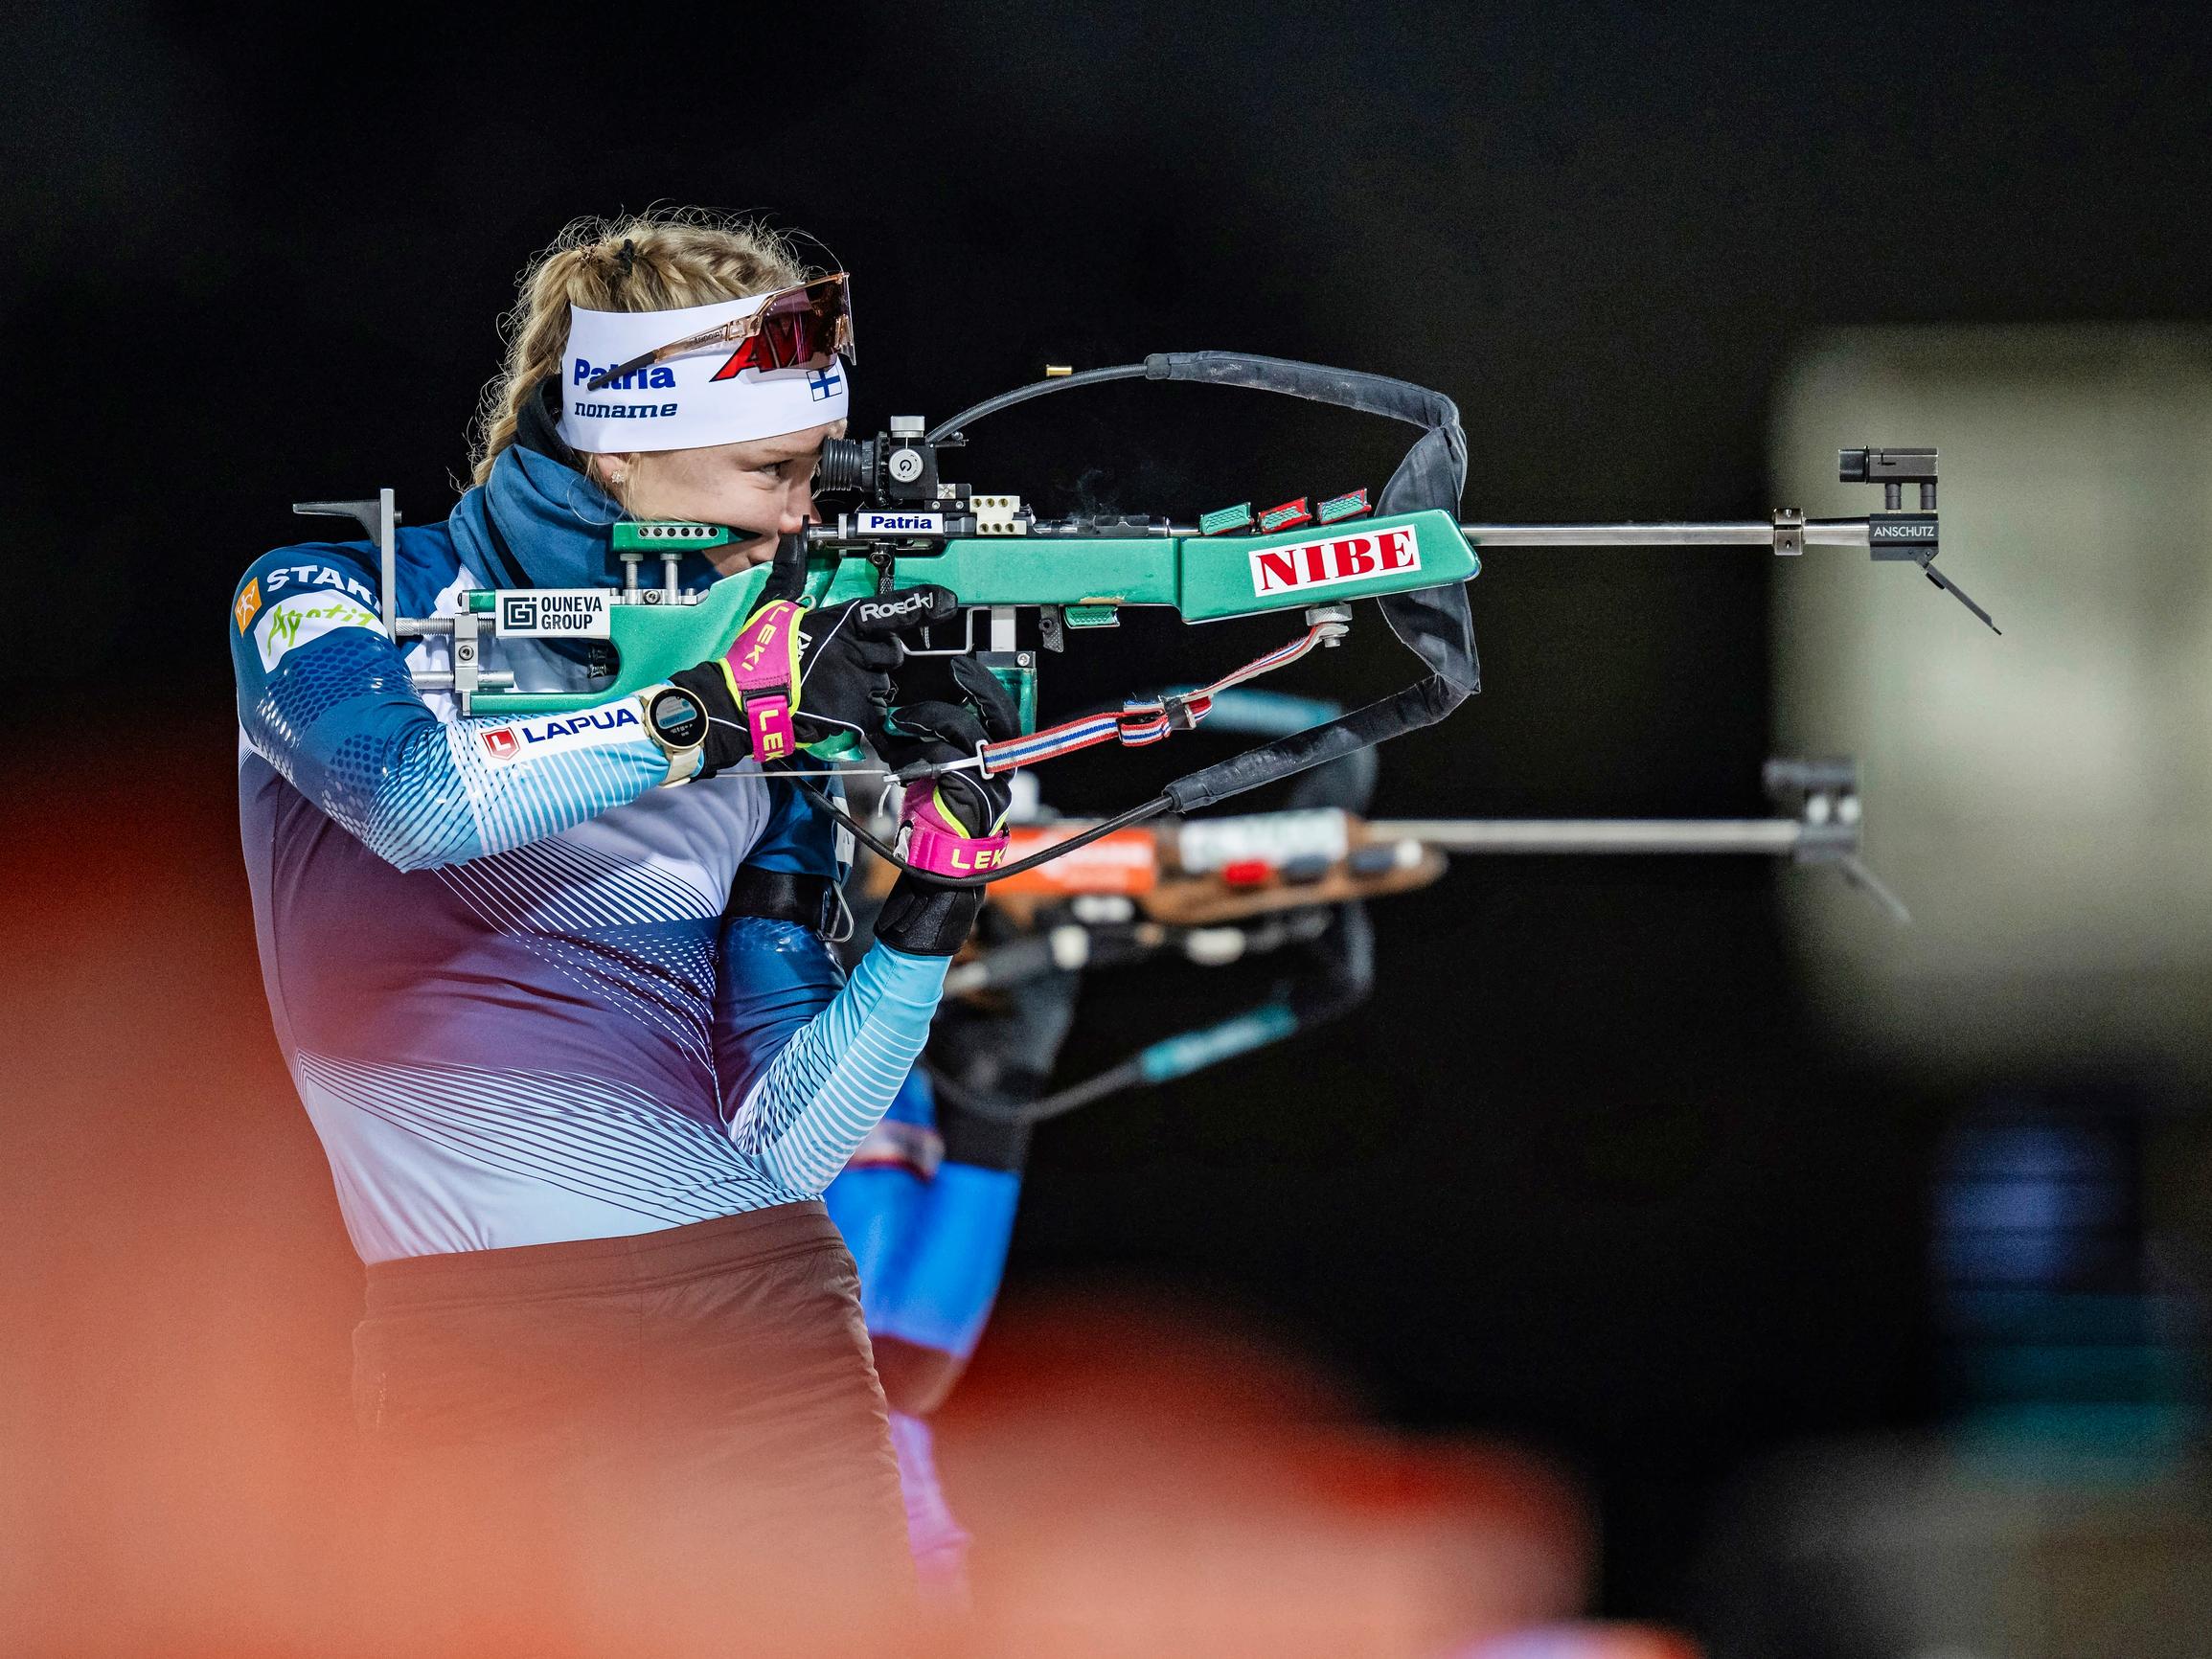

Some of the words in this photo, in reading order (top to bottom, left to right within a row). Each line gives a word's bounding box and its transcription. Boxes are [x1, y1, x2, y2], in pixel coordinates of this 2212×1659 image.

[573, 357, 676, 391] Patria
[575, 402, 678, 419] noname
[870, 515, 933, 530] Patria
[1255, 530, 1415, 591] NIBE
[540, 596, 603, 612] OUNEVA
[540, 614, 593, 630] GROUP
[741, 605, 790, 671] LEKI
[522, 707, 640, 744] LAPUA
